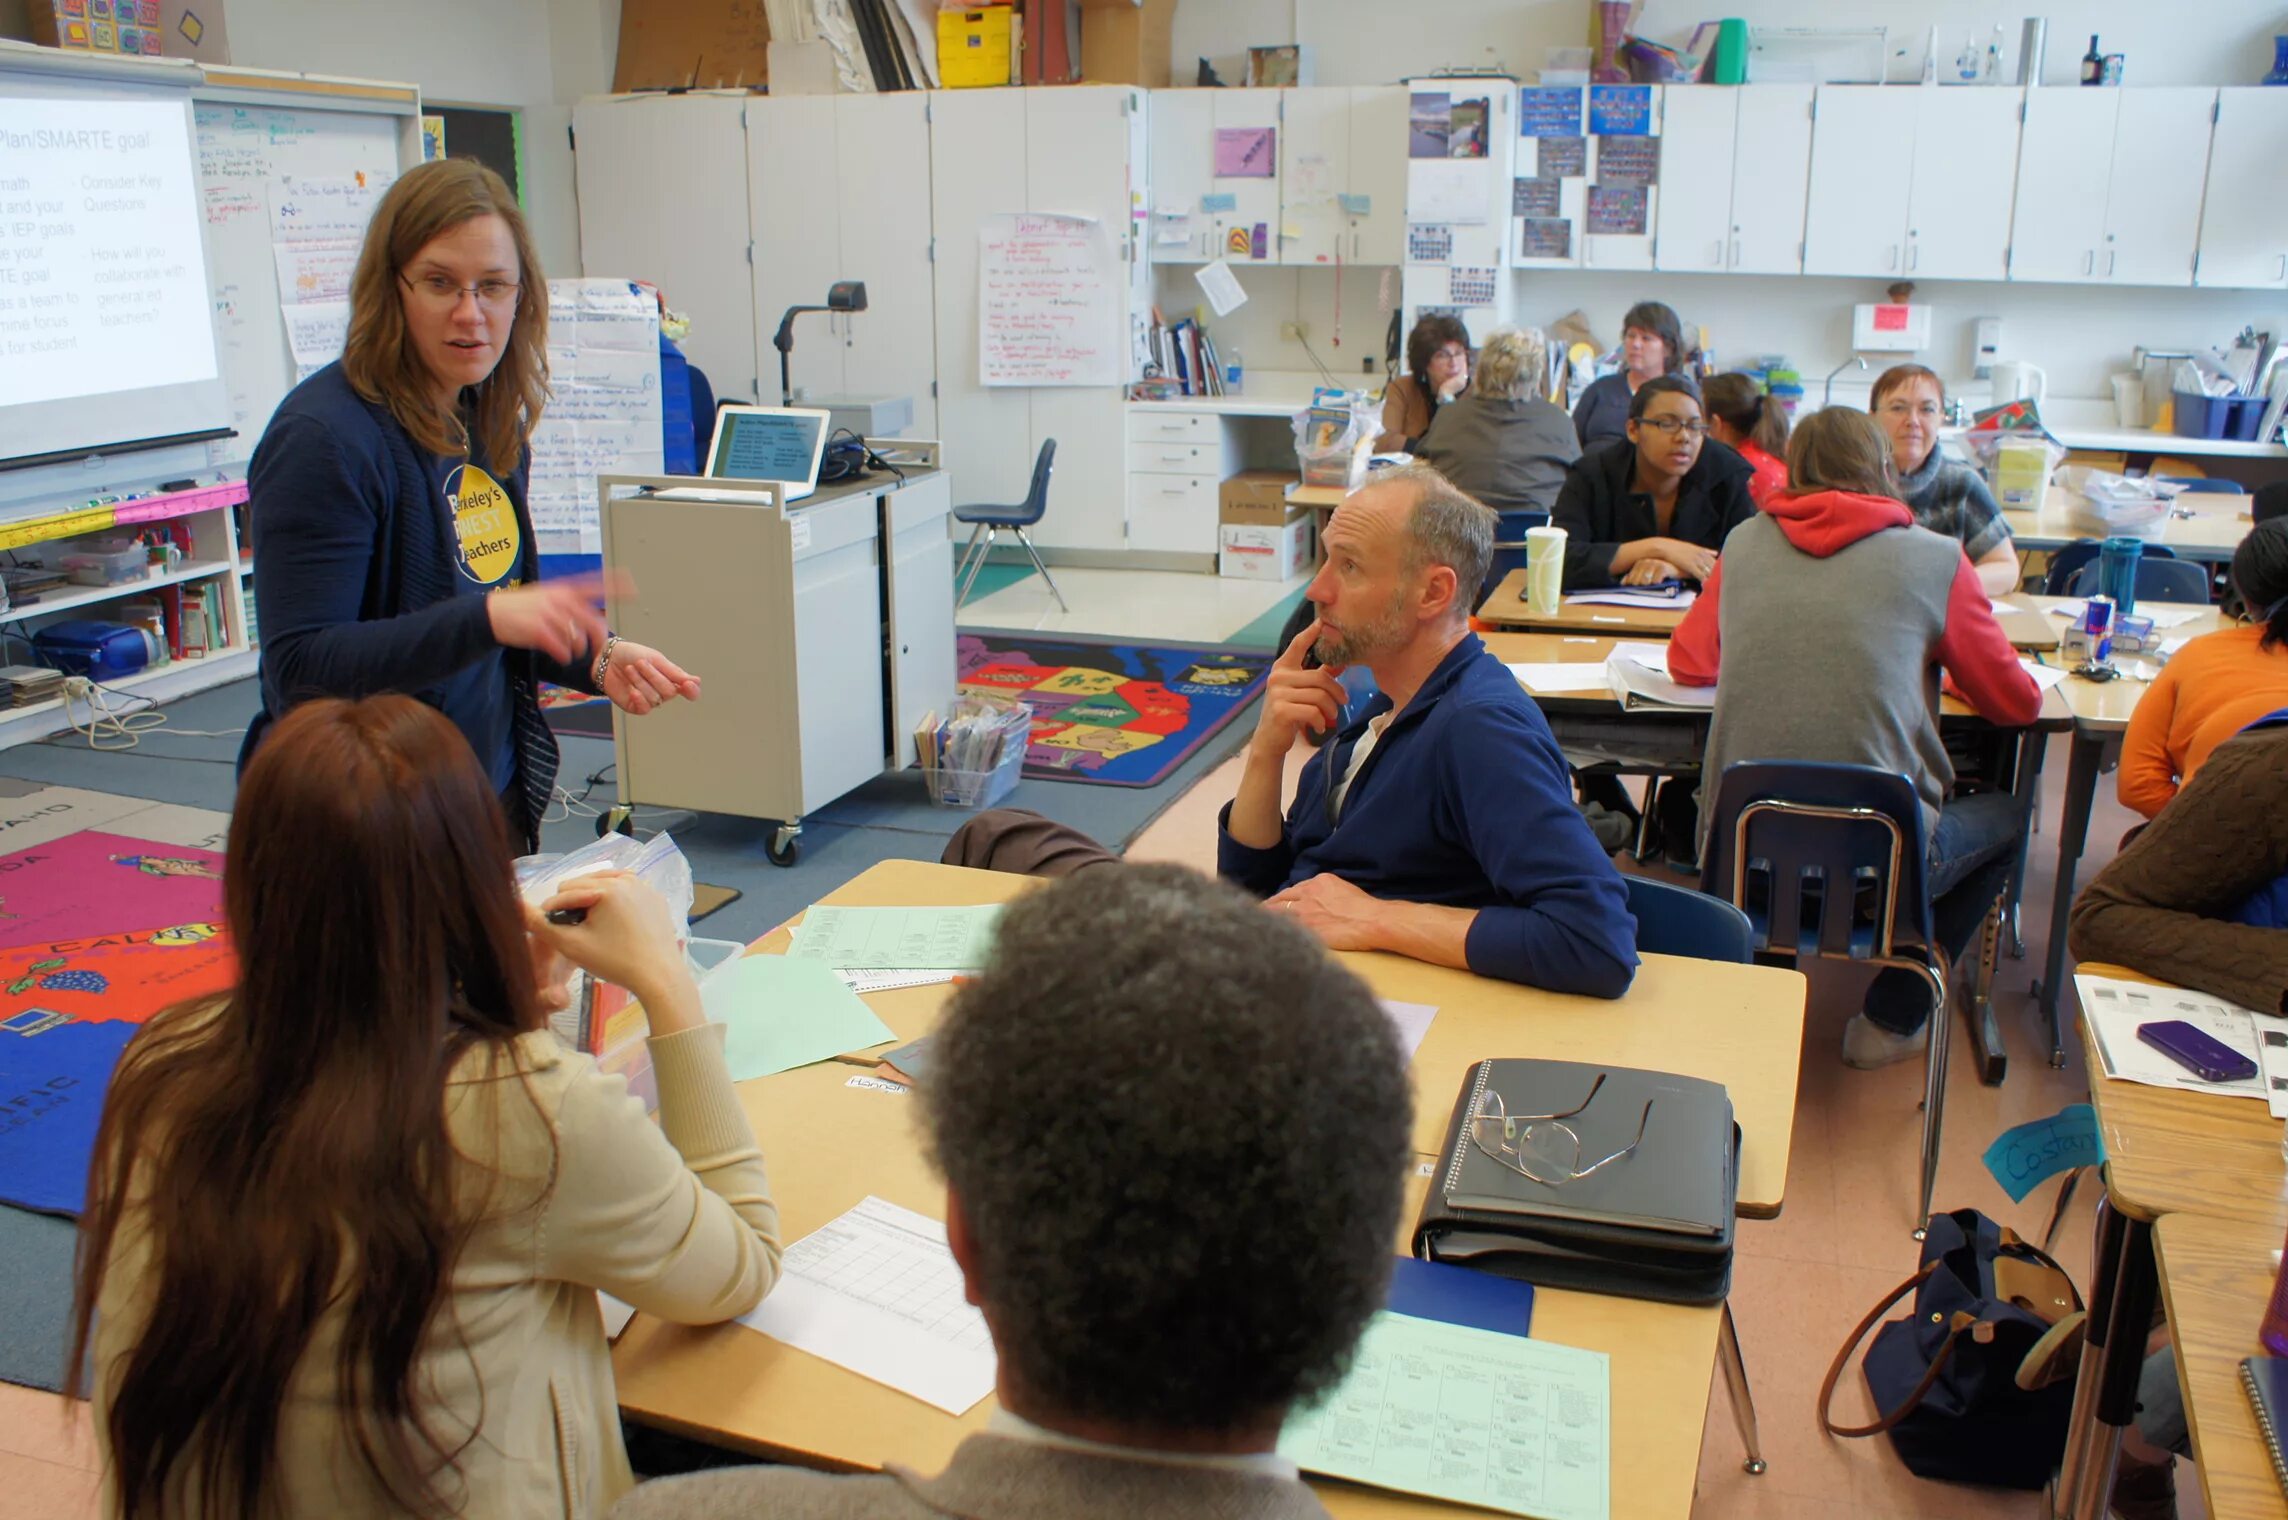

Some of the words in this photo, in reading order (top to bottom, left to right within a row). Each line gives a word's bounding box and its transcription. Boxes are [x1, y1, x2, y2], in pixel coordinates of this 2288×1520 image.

[118, 131, 150, 153] goal
[81, 175, 135, 190] Consider
[139, 173, 162, 191] Key
[7, 199, 32, 213] and
[36, 201, 64, 216] your
[84, 196, 146, 213] Questions
[12, 222, 36, 237] IEP
[40, 221, 76, 240] goals
[15, 246, 43, 264] your
[91, 247, 120, 262] How
[123, 246, 141, 260] will
[146, 248, 166, 264] you
[22, 267, 50, 286] goal
[94, 267, 160, 284] collaborate
[164, 264, 186, 279] with
[30, 294, 63, 309] team
[66, 292, 80, 306] to
[96, 290, 144, 312] general
[146, 289, 163, 303] ed
[33, 315, 70, 330] focus
[99, 308, 160, 328] teachers?
[7, 340, 26, 356] for
[30, 335, 78, 353] student
[447, 486, 502, 515] Berkeley's
[458, 537, 511, 563] Teachers
[0, 803, 73, 831] AHO
